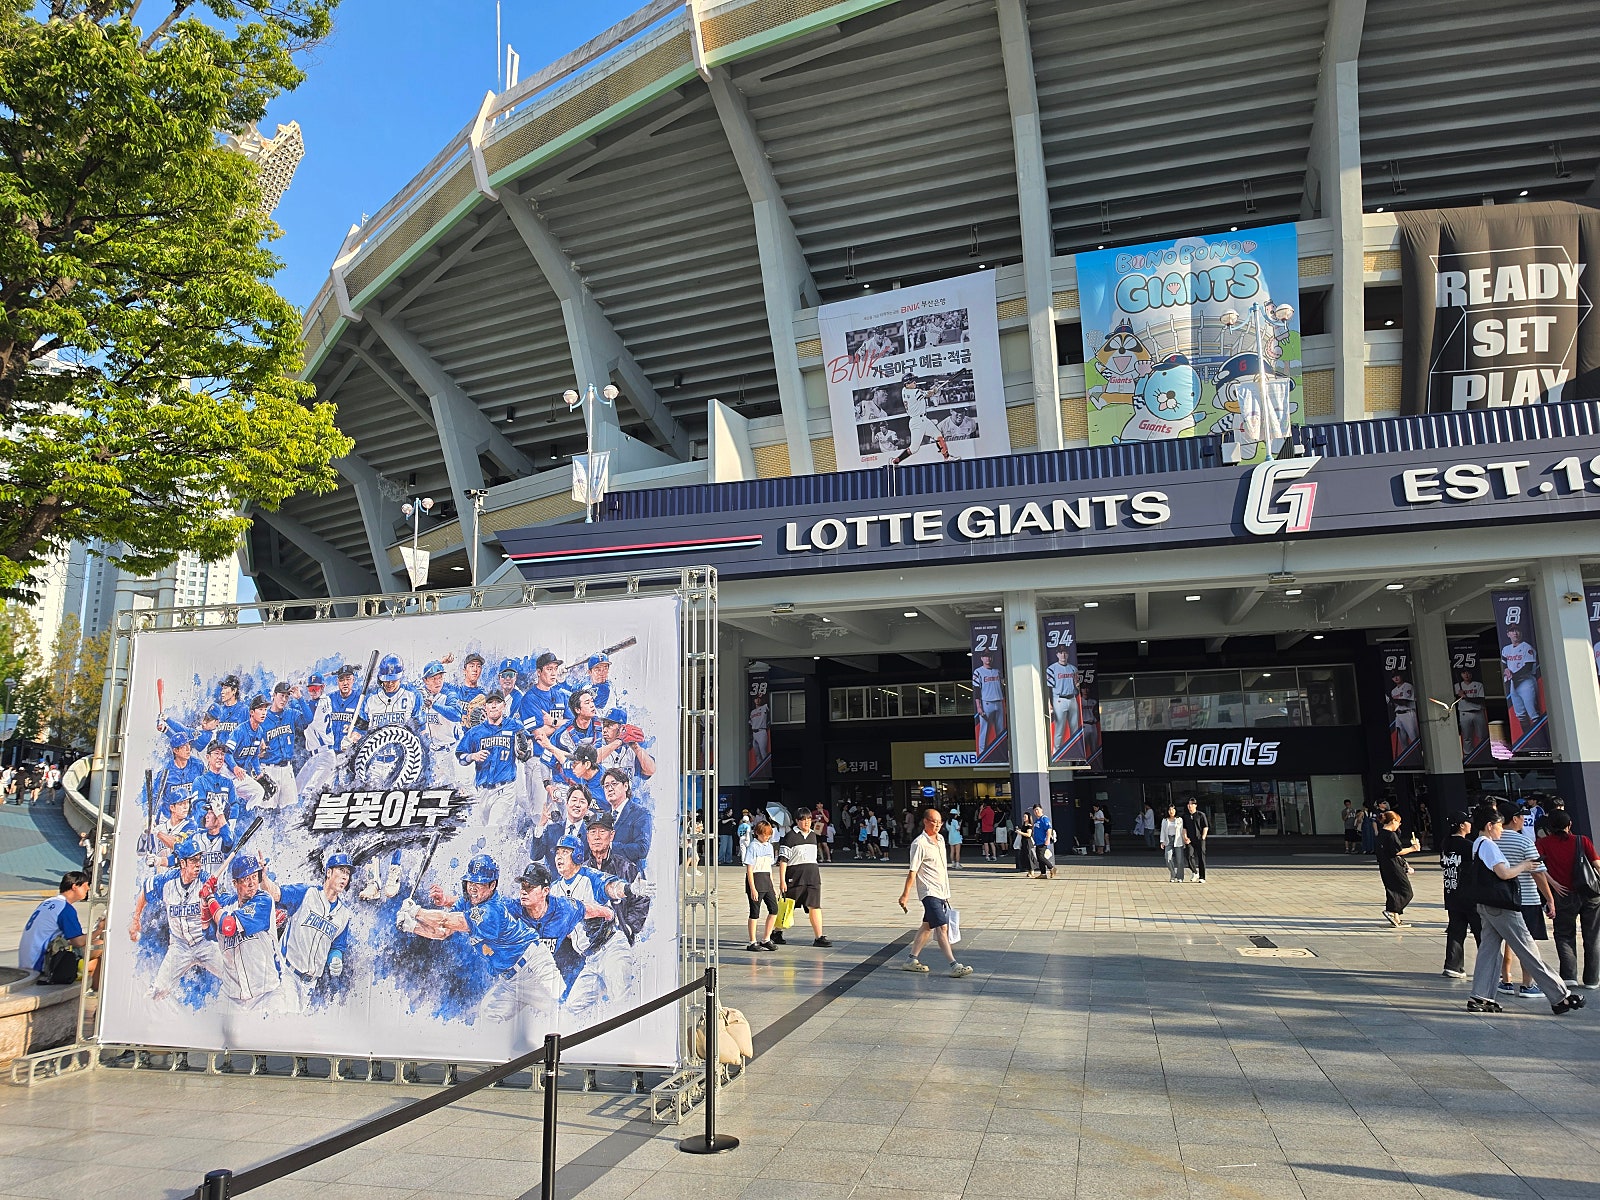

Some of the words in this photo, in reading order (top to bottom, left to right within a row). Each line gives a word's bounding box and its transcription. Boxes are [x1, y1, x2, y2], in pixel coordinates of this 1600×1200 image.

[1116, 241, 1241, 273] BONOBONO
[1116, 262, 1259, 314] GIANTS
[1434, 262, 1587, 308] READY
[1472, 316, 1557, 357] SET
[827, 346, 890, 383] BNK
[872, 358, 917, 379] 가을야구
[1110, 376, 1132, 384] Giants
[1451, 369, 1570, 410] PLAY
[1139, 420, 1172, 434] Giants
[786, 510, 943, 551] LOTTE
[957, 491, 1172, 539] GIANTS
[1505, 606, 1521, 625] 8
[975, 633, 999, 652] 21
[1046, 629, 1074, 648] 34
[1385, 655, 1407, 671] 91
[1453, 653, 1476, 669] 25
[750, 682, 767, 695] 38
[267, 724, 293, 740] FIGHTERS
[480, 736, 511, 749] FIGHTERS
[1164, 737, 1280, 767] Giants
[500, 750, 510, 760] 17
[849, 761, 878, 772] 짐캐리
[312, 790, 454, 830] 불꽃야구
[1523, 817, 1534, 827] 52
[170, 904, 201, 917] FIGHTERS
[26, 910, 40, 931] 8
